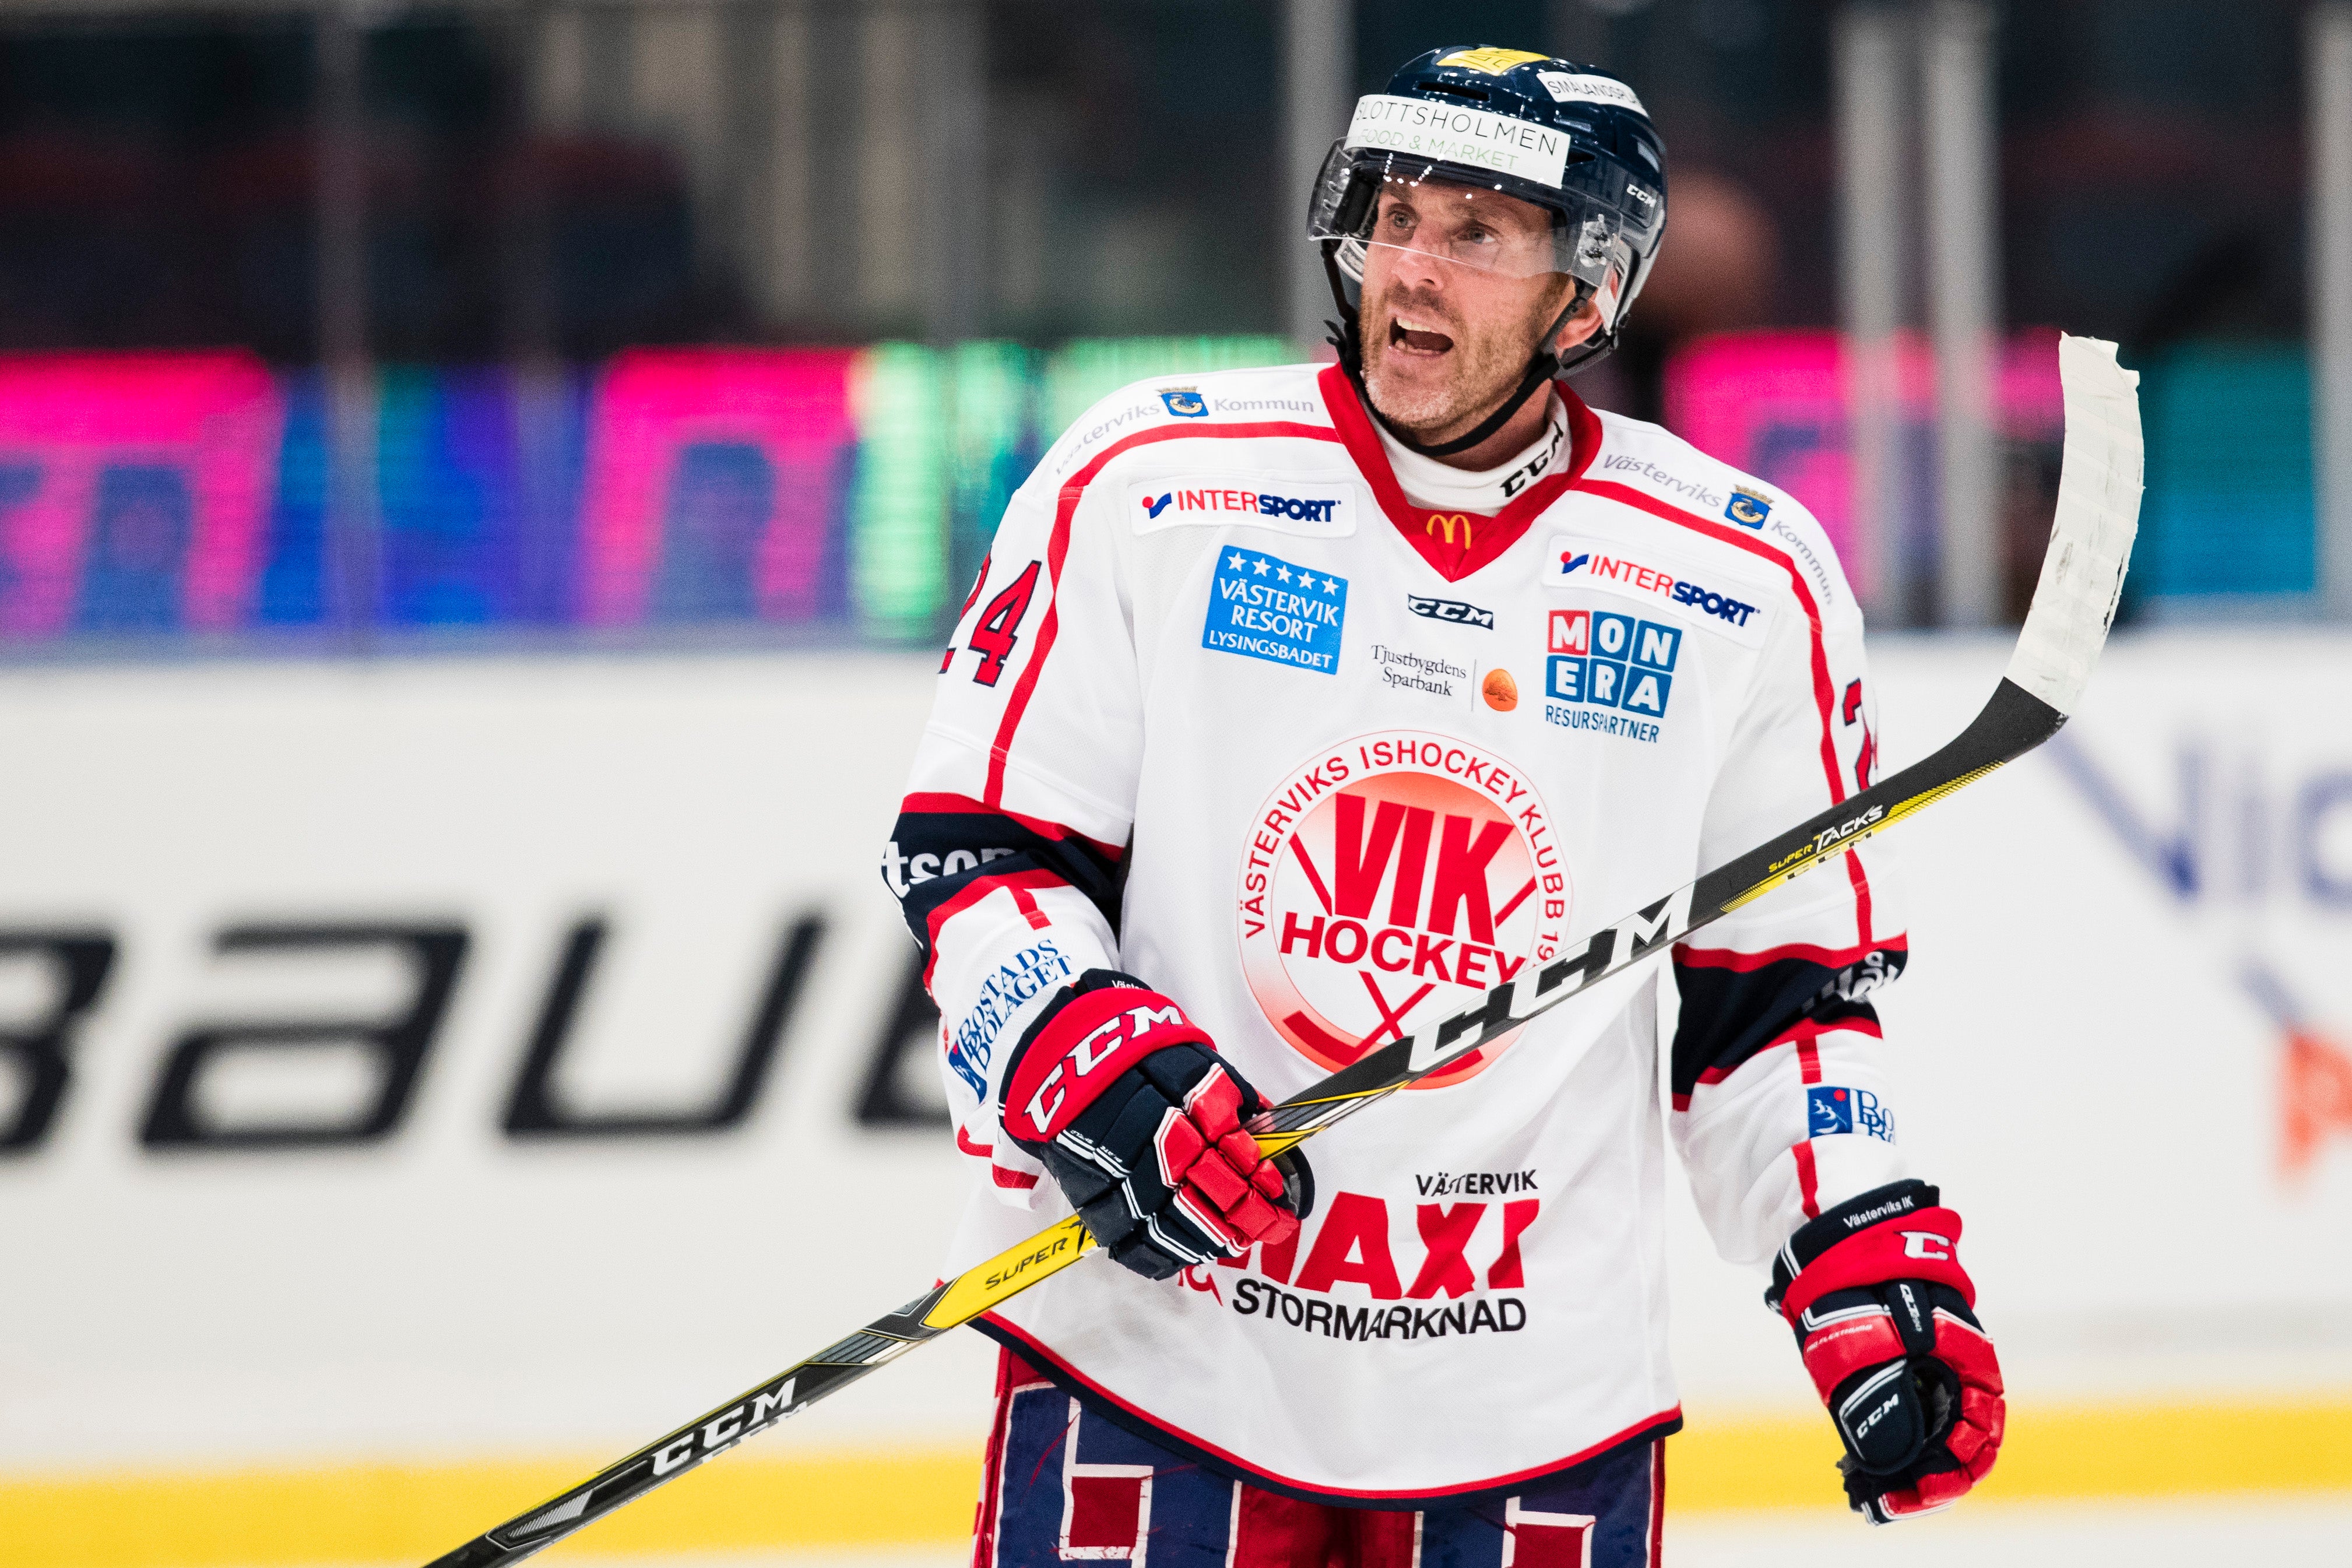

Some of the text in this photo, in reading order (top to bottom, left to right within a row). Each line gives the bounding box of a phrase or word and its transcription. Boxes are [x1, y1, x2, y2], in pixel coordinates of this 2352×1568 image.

[1356, 100, 1558, 157] SLOTTSHOLMEN
[1360, 128, 1519, 169] FOOD & MARKET
[1626, 183, 1657, 208] CCM
[1214, 398, 1315, 413] Kommun
[1499, 420, 1564, 498] CCM
[1178, 490, 1342, 523] INTERSPORT
[1603, 453, 1834, 607] Västerviks Kommun
[1218, 577, 1340, 627] VÄSTERVIK
[1407, 596, 1493, 628] CCM
[1590, 554, 1756, 629] INTERSPORT
[1208, 630, 1334, 669] LYSINGSBADET
[1230, 604, 1319, 644] RESORT
[1371, 644, 1467, 680] Tjustbygdens
[1382, 666, 1454, 697] Sparbank
[1239, 756, 1350, 939] VÄSTERVIKS
[1532, 931, 1559, 968] 19
[1768, 843, 1813, 873] SUPER
[1812, 804, 1884, 855] TACKS
[1335, 791, 1517, 947] VIK
[1279, 910, 1526, 992] HOCKEY
[1405, 881, 1695, 1074] CCM
[958, 938, 1065, 1063] BOSTADS
[968, 954, 1074, 1075] BOLAGET
[1021, 1004, 1184, 1134] CCM
[1415, 1169, 1539, 1198] VÄSTERVIK
[1843, 1195, 1915, 1229] Västerviks IK
[985, 1237, 1068, 1291] SUPER
[1232, 1278, 1527, 1342] STORMARKNAD
[651, 1377, 796, 1476] CCM
[1856, 1393, 1900, 1440] CCM
